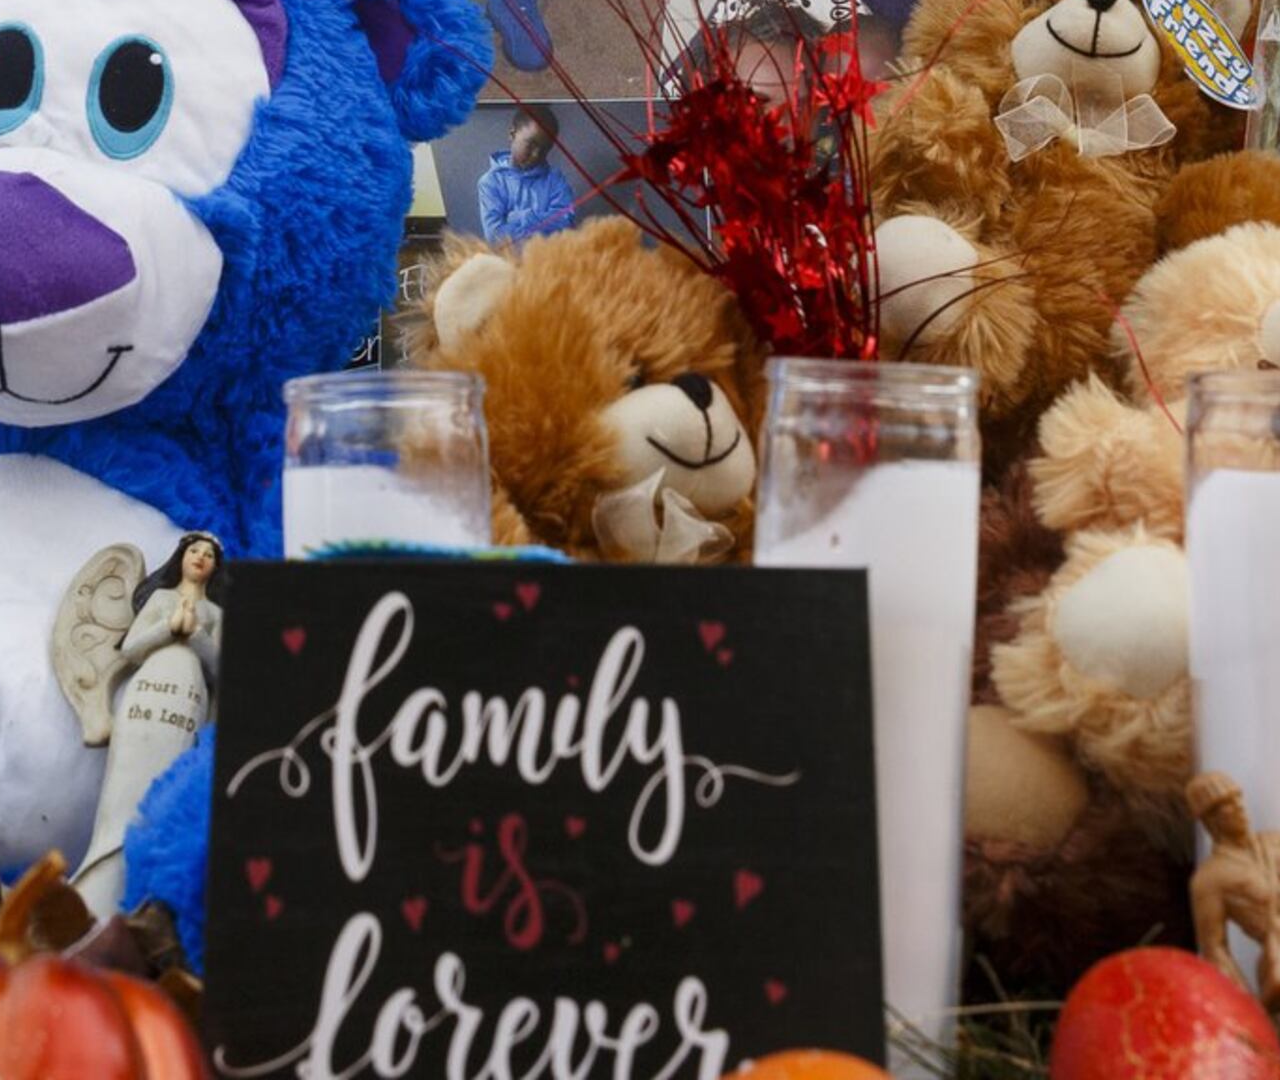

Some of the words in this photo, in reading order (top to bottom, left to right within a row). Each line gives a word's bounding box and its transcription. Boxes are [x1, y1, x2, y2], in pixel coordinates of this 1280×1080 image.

[127, 705, 153, 722] the
[280, 590, 720, 882] family
[435, 812, 587, 951] is
